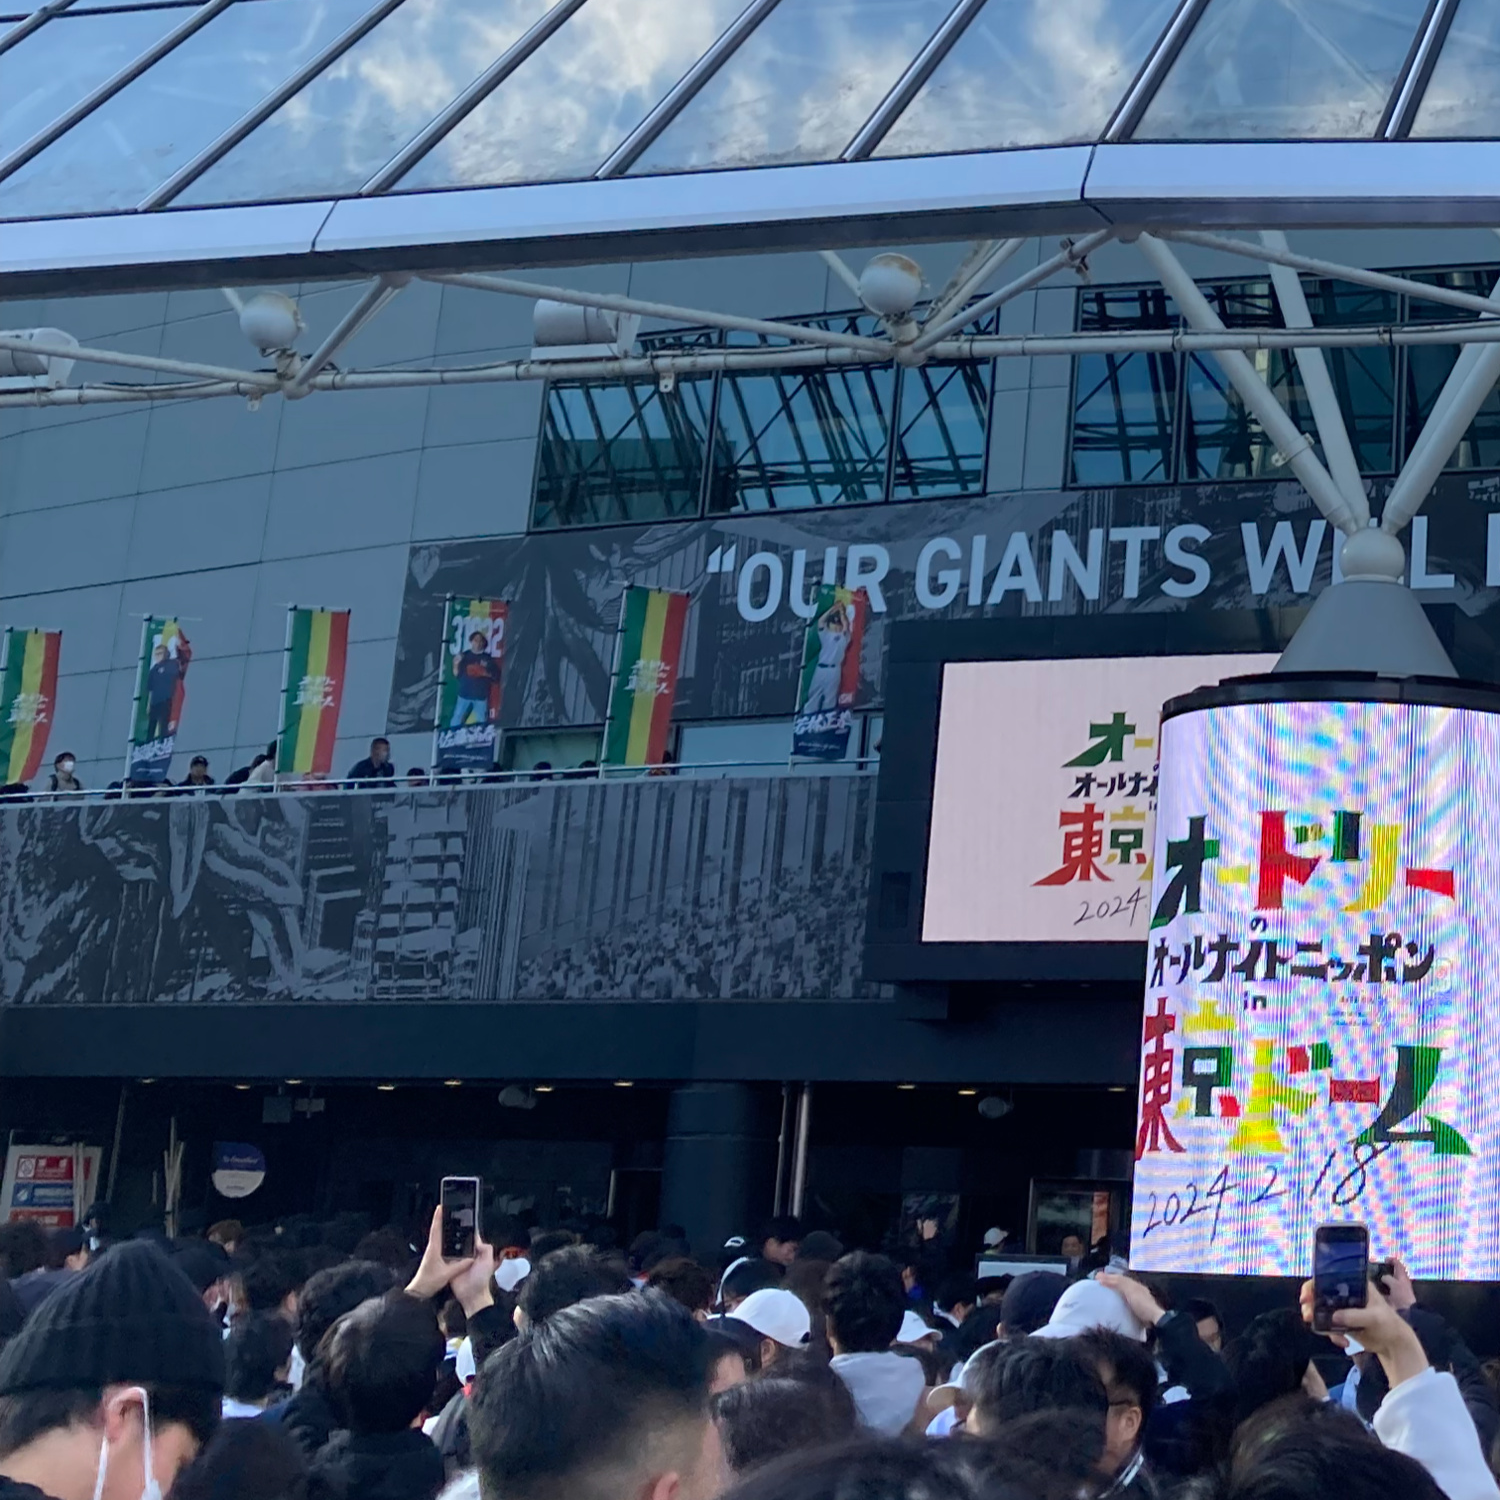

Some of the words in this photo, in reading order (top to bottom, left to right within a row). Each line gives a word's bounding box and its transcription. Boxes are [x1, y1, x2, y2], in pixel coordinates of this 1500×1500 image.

[915, 523, 1212, 609] GIANTS
[1241, 515, 1455, 595] WIL
[1030, 803, 1153, 887] 東京
[1150, 810, 1456, 931] オードリー
[1150, 931, 1435, 989] オールナイトニッポン
[1249, 916, 1267, 932] の
[1243, 991, 1268, 1011] in
[1134, 996, 1475, 1161] 東京ドーム
